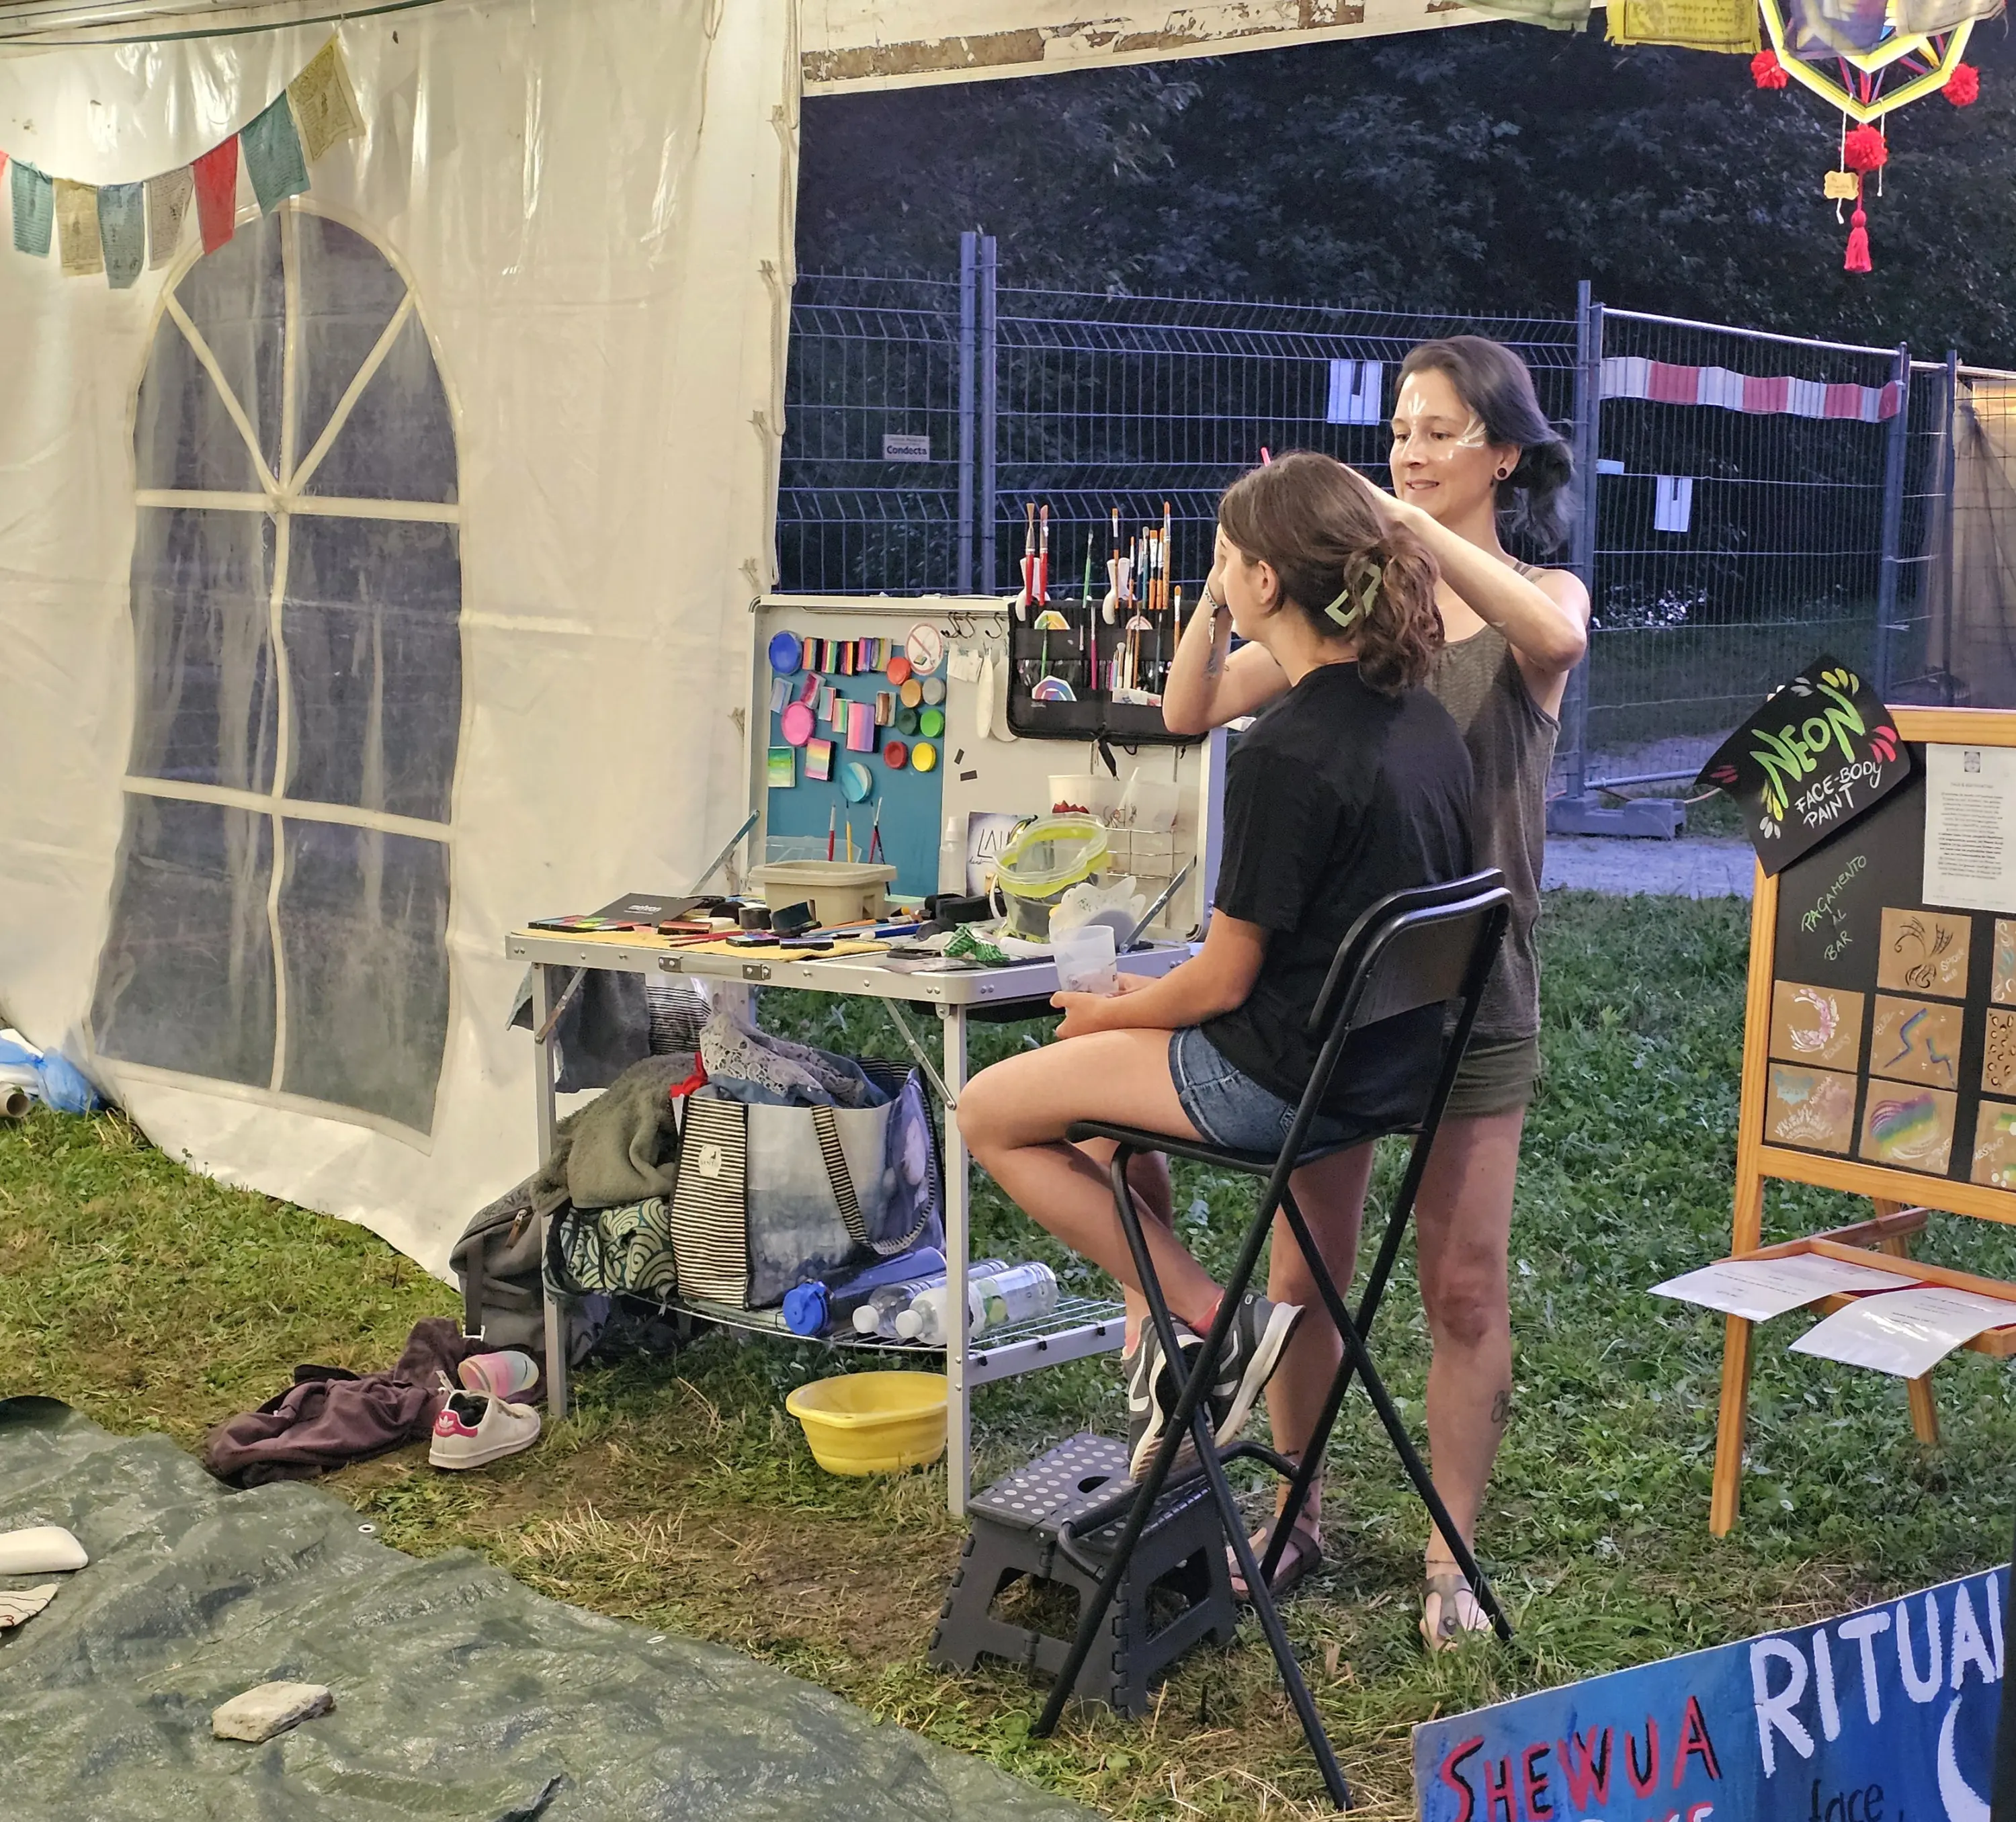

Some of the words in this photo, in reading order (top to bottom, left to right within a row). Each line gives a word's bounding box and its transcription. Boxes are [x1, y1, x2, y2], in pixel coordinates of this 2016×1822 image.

[887, 445, 927, 455] Condecta
[1750, 684, 1865, 809] NEON
[1803, 782, 1854, 829] PAINT
[1801, 855, 1866, 932] PAGAMENTO
[1832, 909, 1847, 926] AL
[1824, 930, 1853, 961] BAR
[1439, 1694, 1723, 1822] SHEWUA
